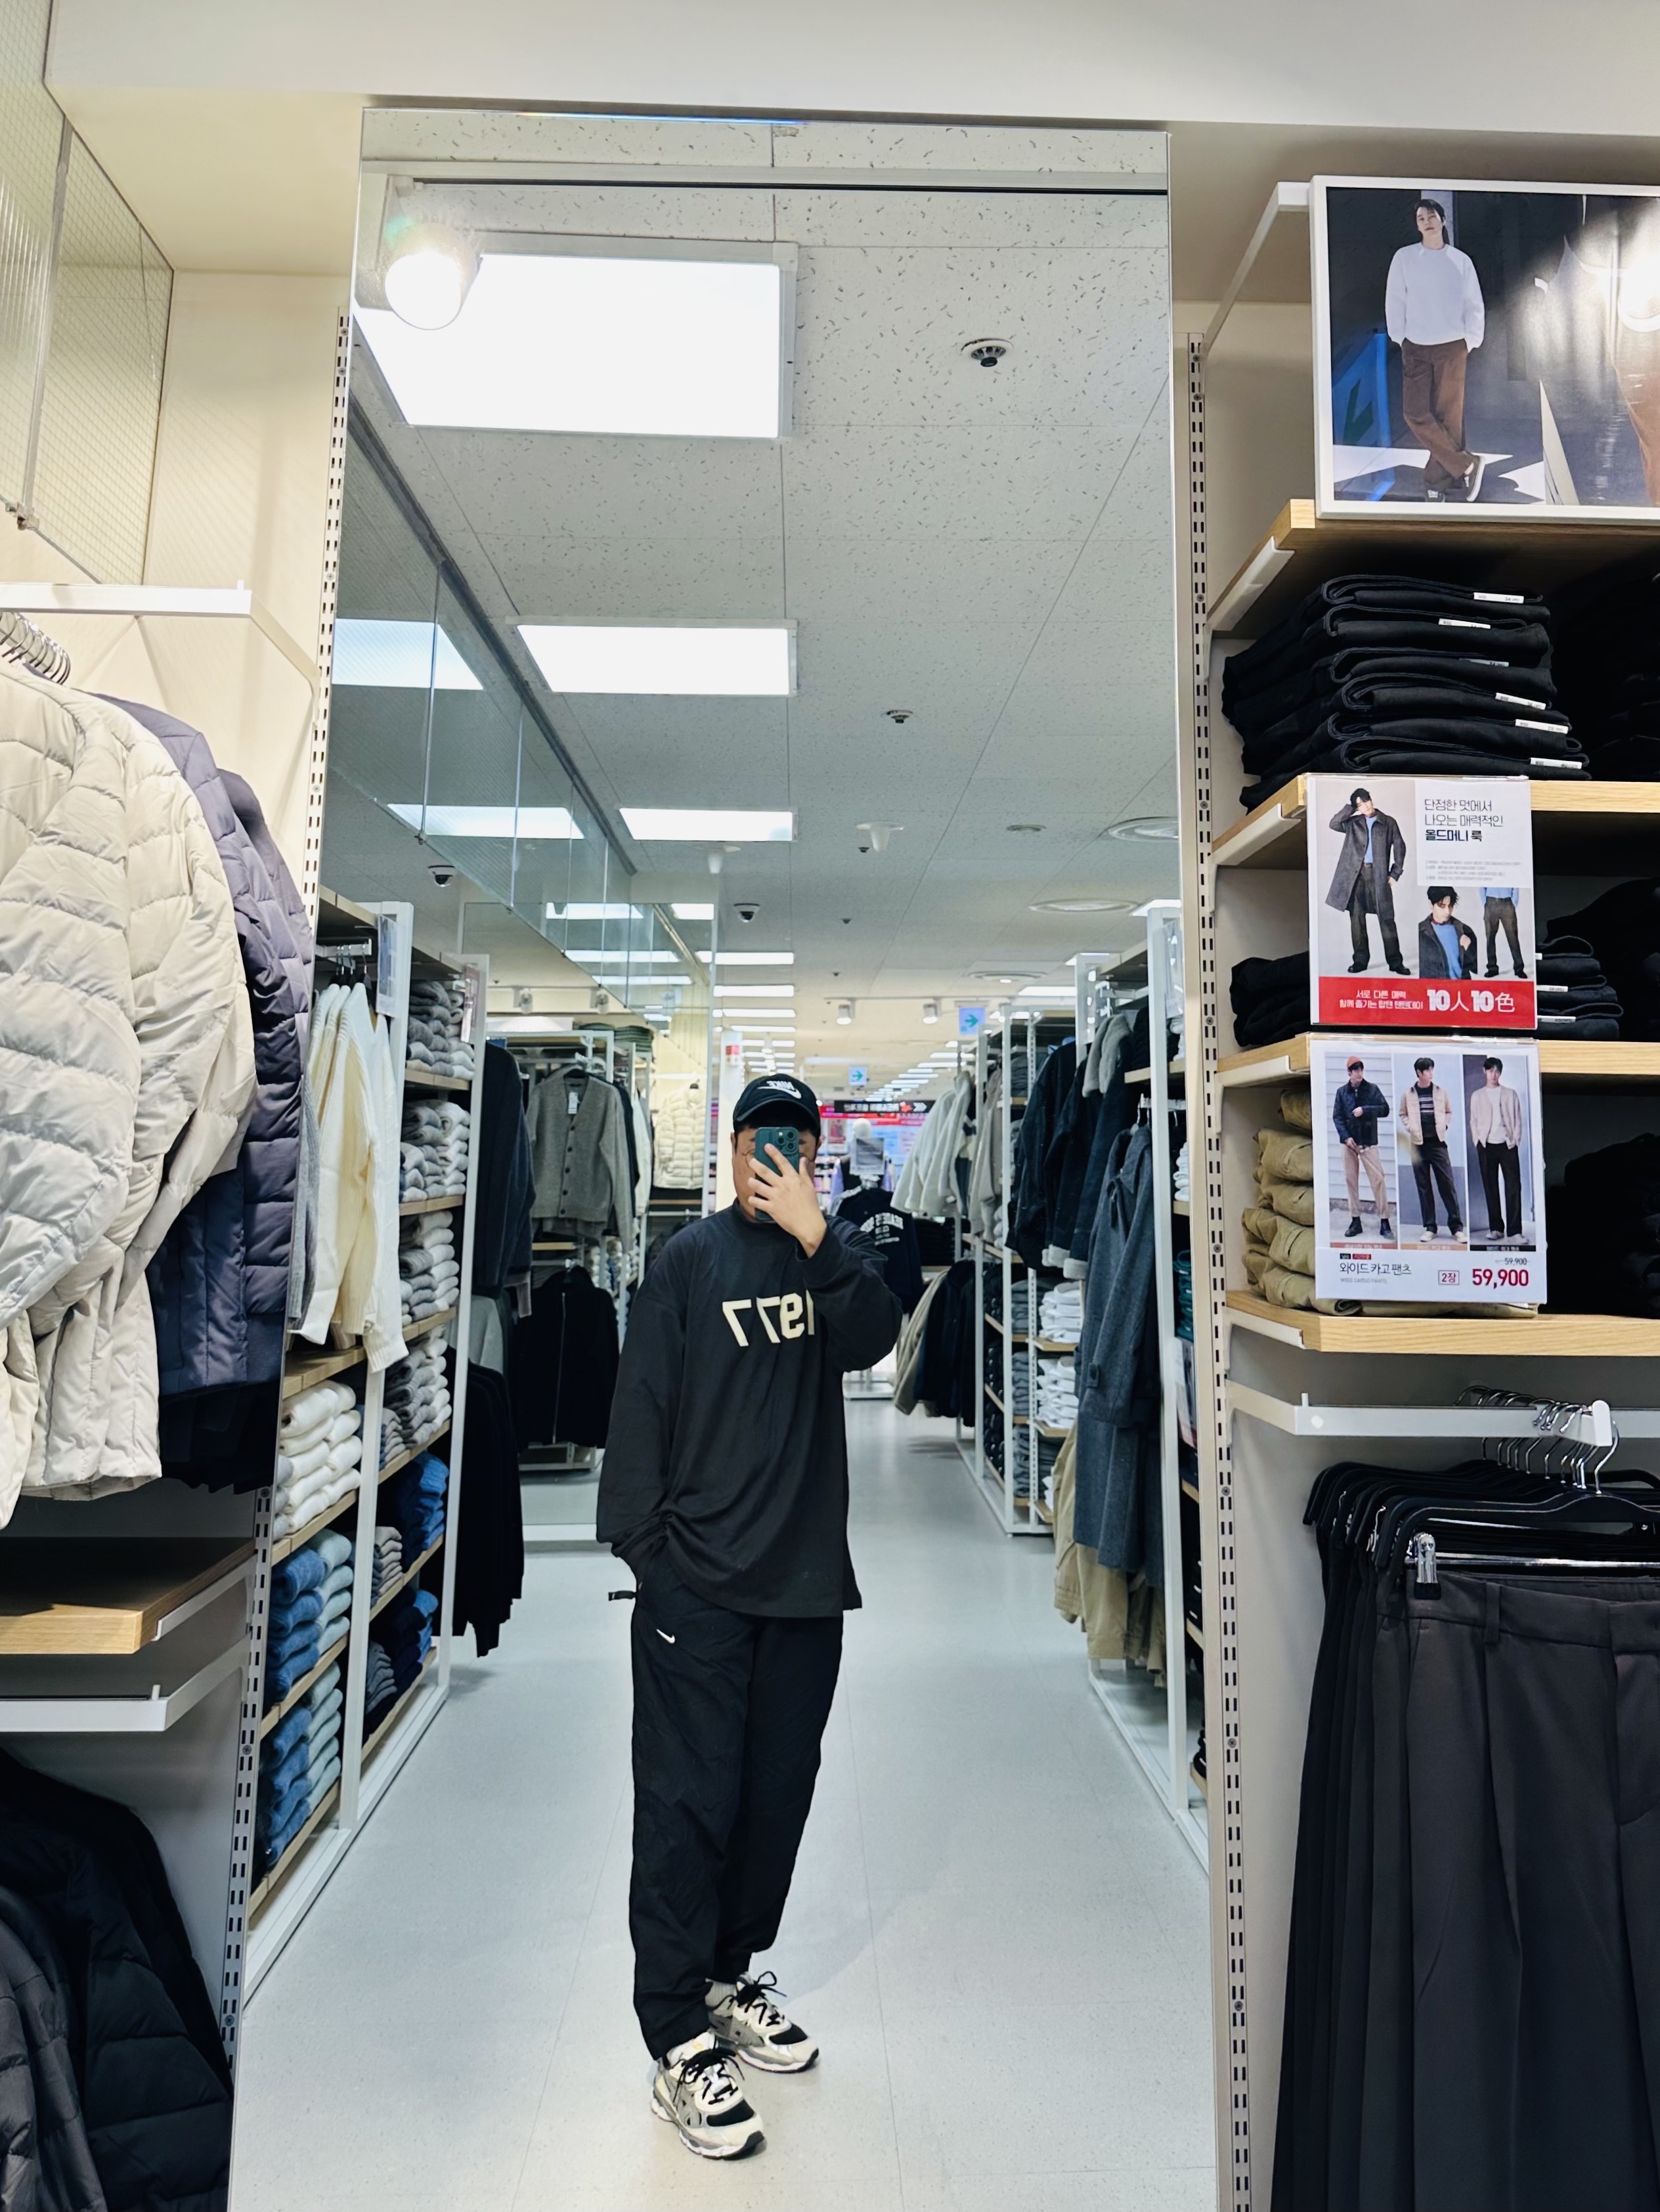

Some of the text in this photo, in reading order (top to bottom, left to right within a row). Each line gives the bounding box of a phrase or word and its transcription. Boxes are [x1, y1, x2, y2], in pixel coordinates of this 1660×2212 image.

[1424, 798, 1493, 812] 단정한 멋에서
[1425, 813, 1504, 827] 나오는 매력적인
[1426, 829, 1483, 842] 올드머니 룩
[1356, 989, 1407, 999] 서로 다른 매력
[1339, 999, 1355, 1008] 함께
[1504, 1257, 1527, 1267] 59,900
[1339, 1262, 1412, 1276] 와이드 카고 팬츠
[1441, 1272, 1456, 1284] 2장
[1472, 1268, 1529, 1290] 59,900
